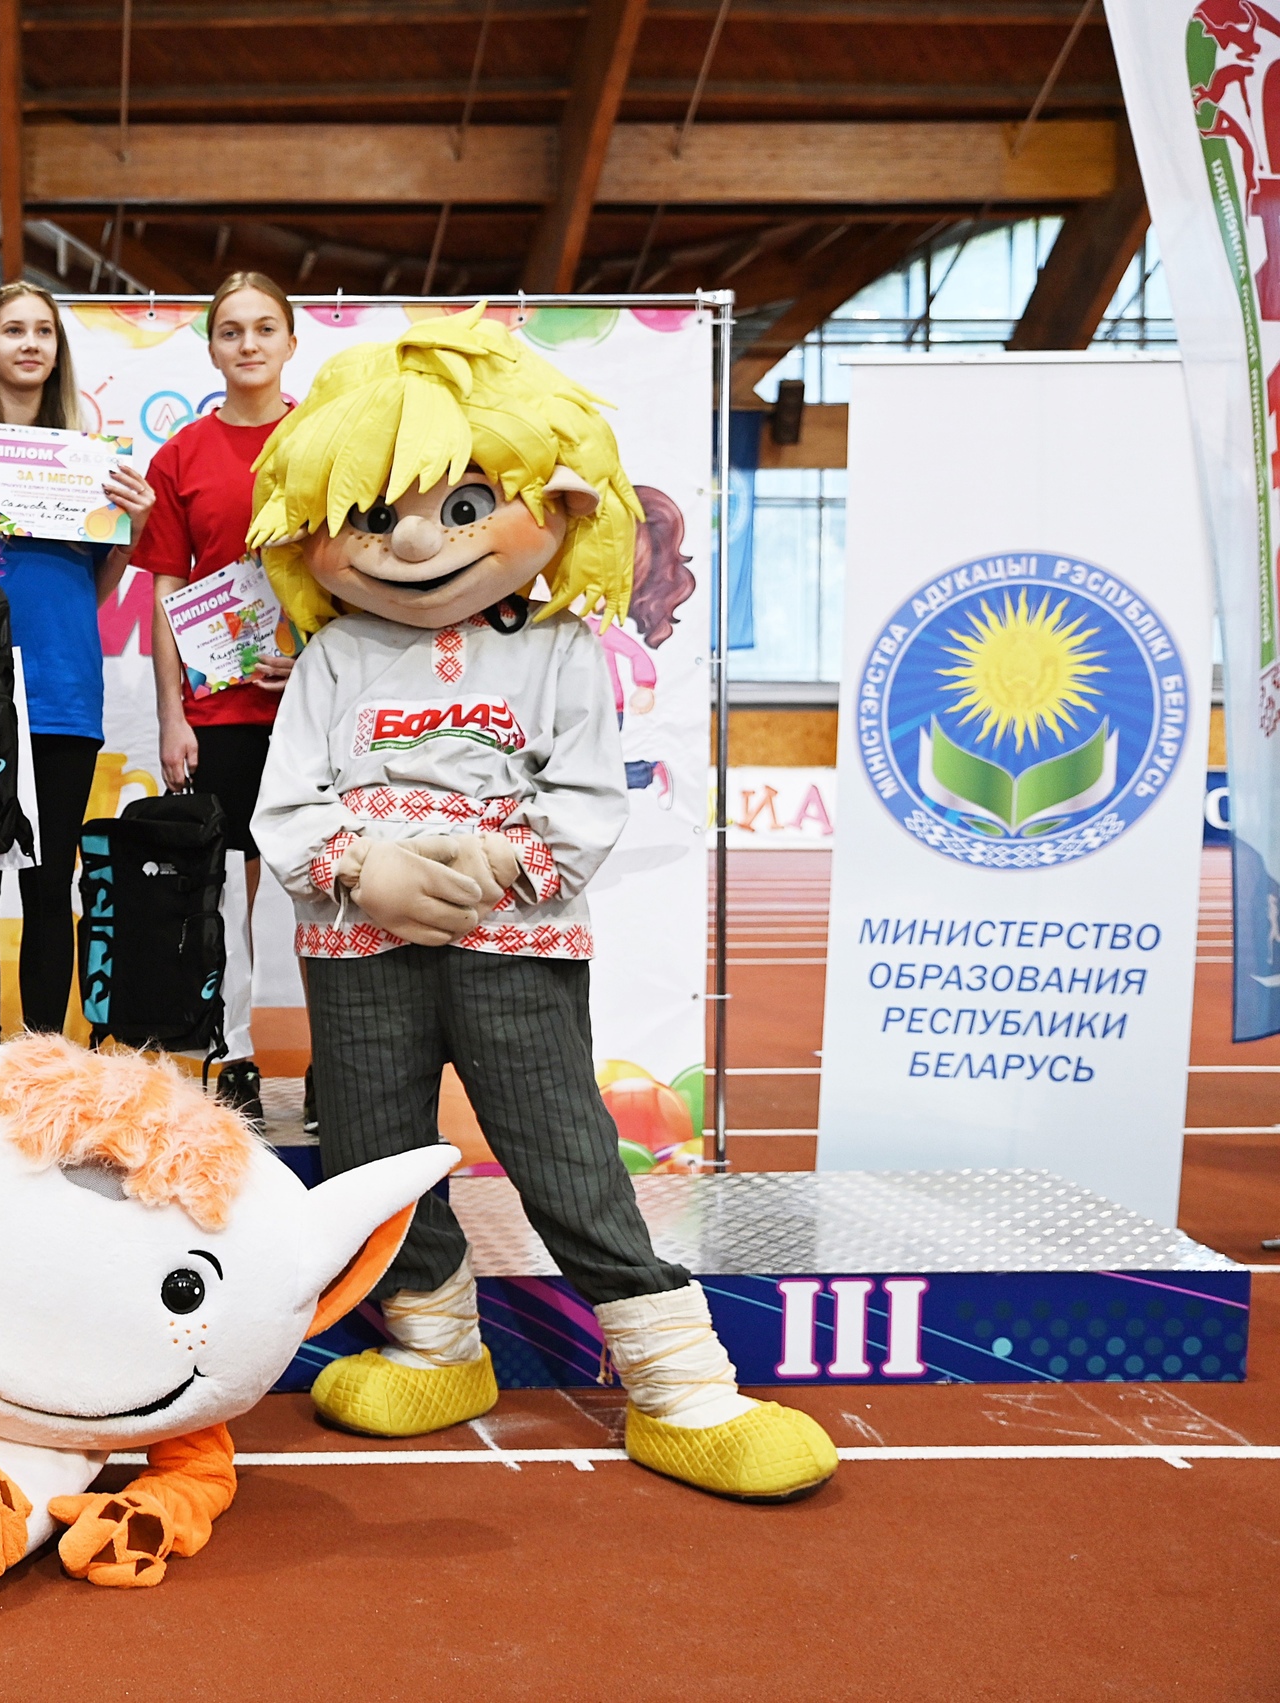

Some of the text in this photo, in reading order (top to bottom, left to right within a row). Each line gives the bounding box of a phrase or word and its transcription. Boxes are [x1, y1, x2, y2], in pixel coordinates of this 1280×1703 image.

[17, 470, 94, 486] ЗА 1 МЕСТО
[171, 591, 230, 628] ДИПЛОМ
[208, 620, 224, 634] ЗА
[860, 556, 1186, 800] МІНІСТЭРСТВА АДУКАЦЫІ РЭСПУБЛІКІ БЕЛАРУСЬ
[372, 703, 490, 741] БФЛА
[858, 918, 1162, 951] МИНИСТЕРСТВО
[869, 962, 1148, 995] ОБРАЗОВАНИЯ
[881, 1007, 1128, 1040] РЕСПУБЛИКИ
[908, 1051, 1095, 1083] БЕЛАРУСЬ
[776, 1278, 928, 1377] III
